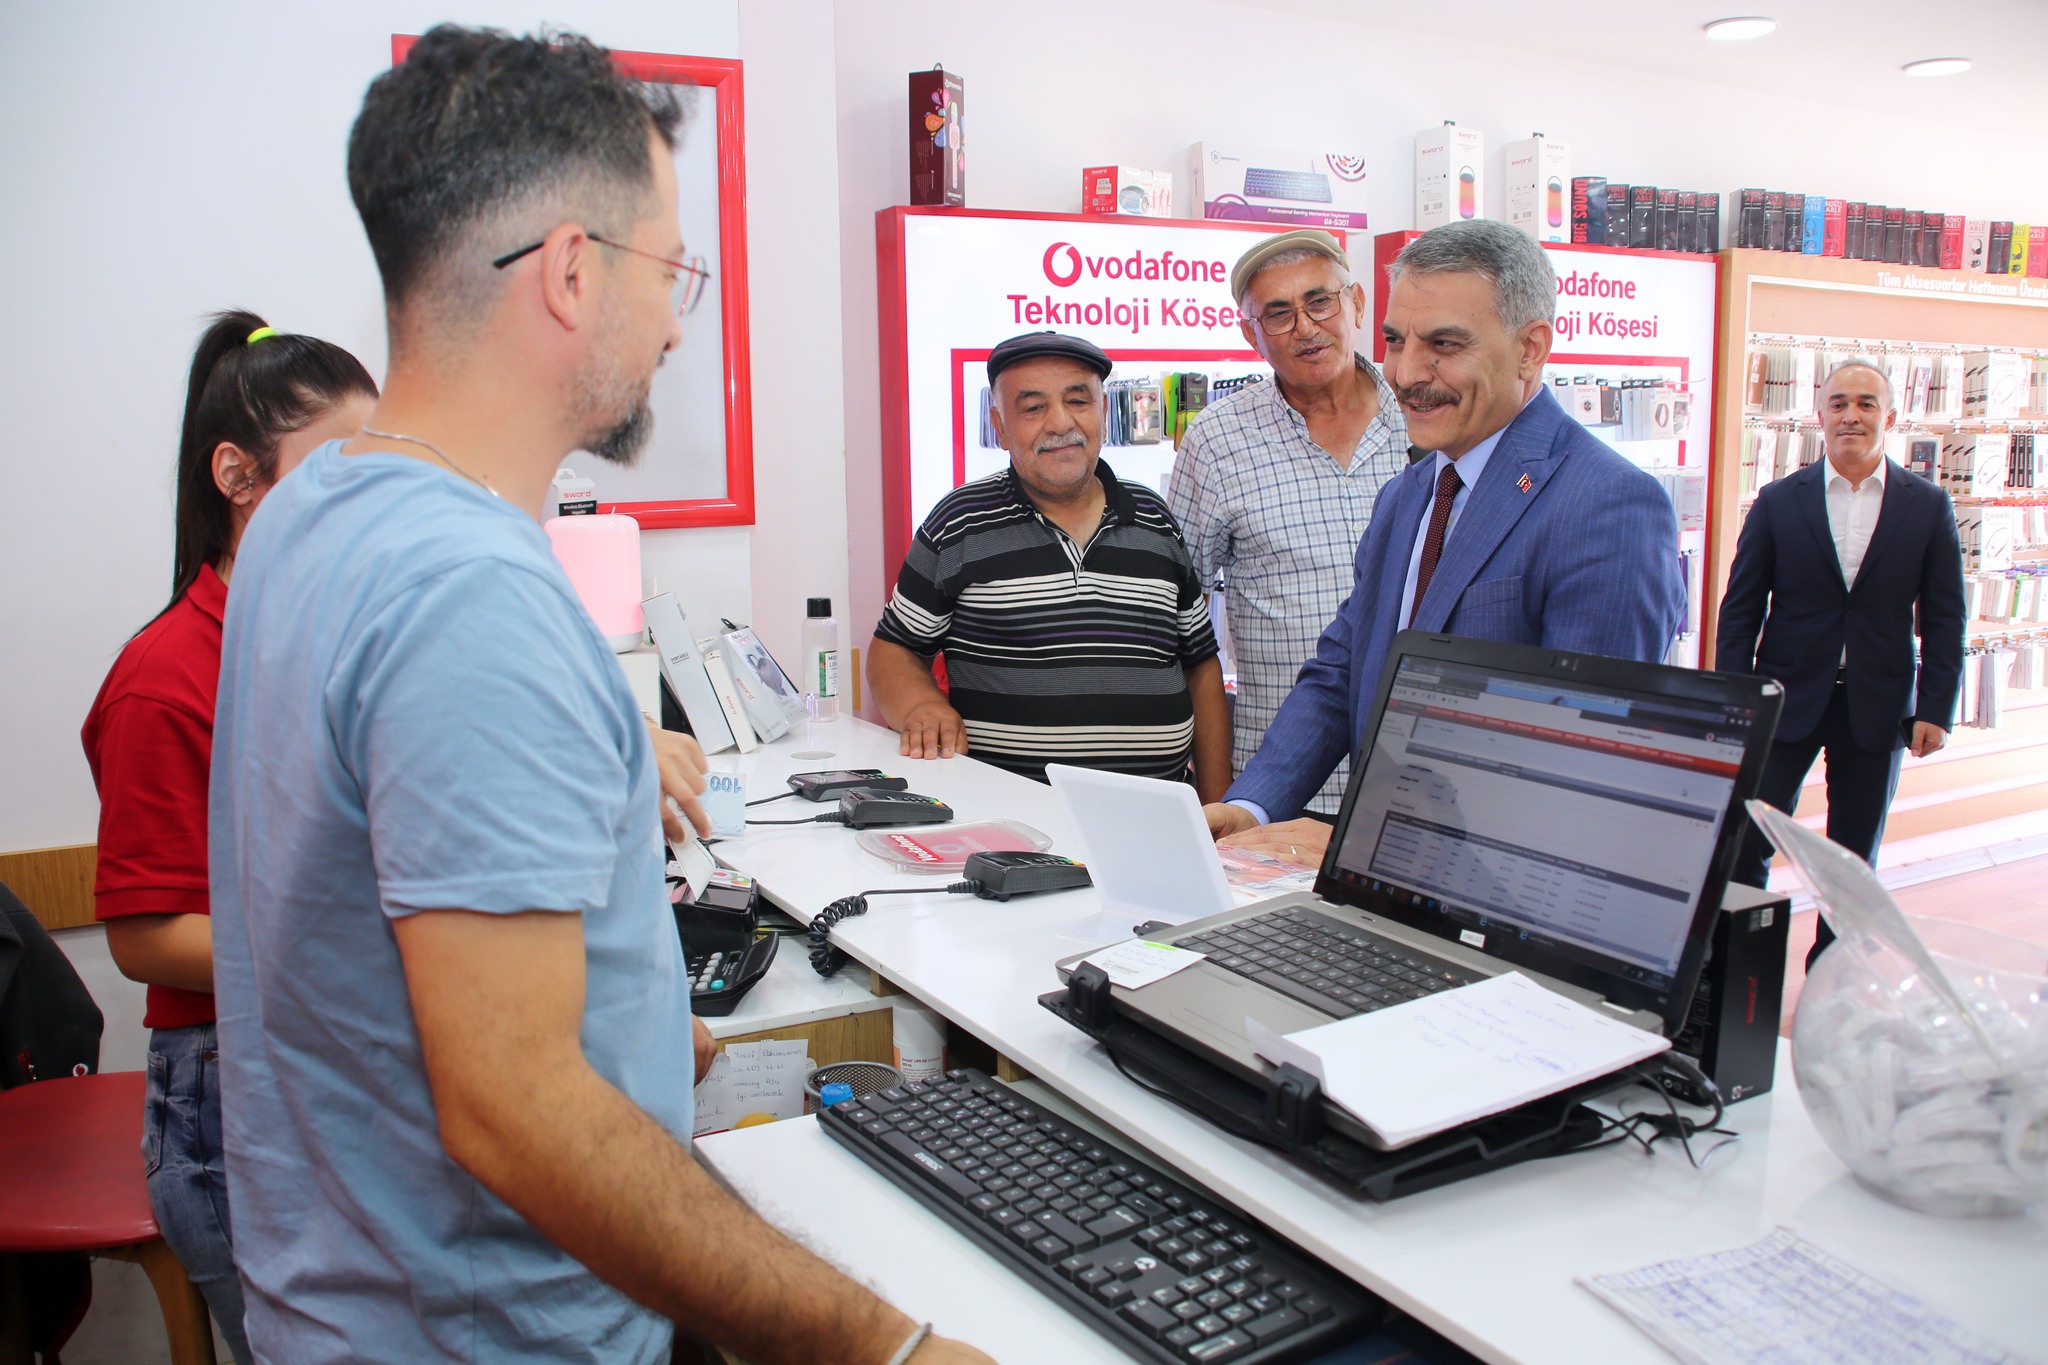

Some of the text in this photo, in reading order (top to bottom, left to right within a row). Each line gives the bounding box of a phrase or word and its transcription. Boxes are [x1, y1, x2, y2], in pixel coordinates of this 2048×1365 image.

[1422, 146, 1444, 154] sword
[1511, 157, 1533, 166] sword
[1294, 209, 1308, 217] Gaming
[1330, 212, 1349, 220] Keyboard
[1574, 179, 1588, 242] BIG SOUND
[1085, 250, 1226, 282] vodafone
[1878, 271, 1900, 288] Tüm
[1904, 274, 1966, 292] Aksesuarlar
[1006, 294, 1149, 334] Teknoloji
[1589, 312, 1658, 340] Köşesi
[736, 677, 754, 700] sword
[726, 696, 736, 715] sword
[710, 775, 742, 794] 100
